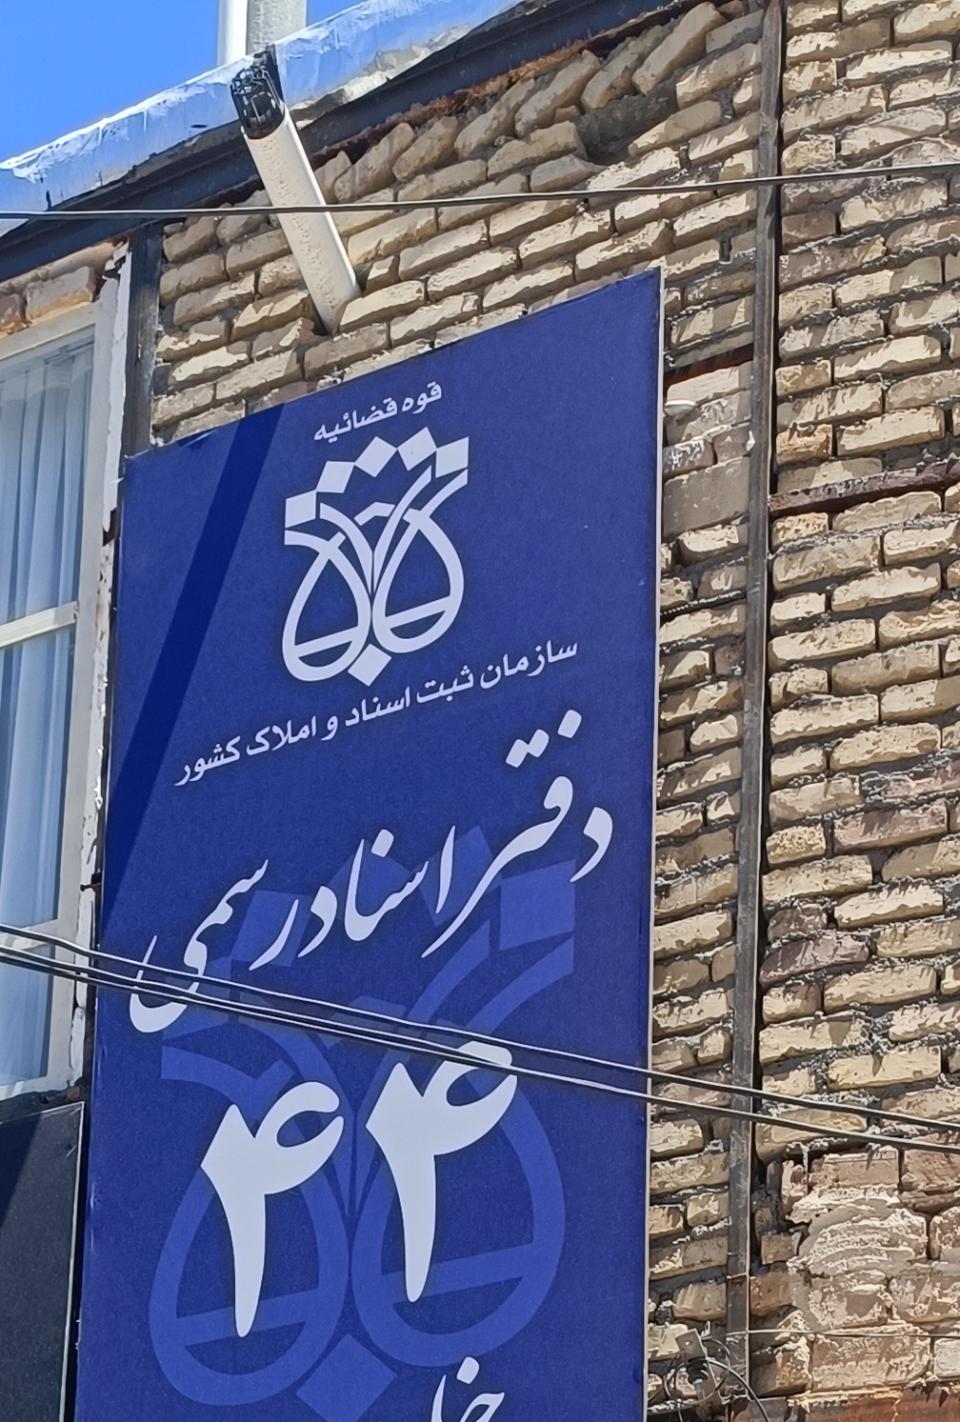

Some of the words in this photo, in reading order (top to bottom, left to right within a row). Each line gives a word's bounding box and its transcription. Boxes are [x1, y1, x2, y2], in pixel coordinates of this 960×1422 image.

[314, 396, 397, 444] قضائیه
[402, 382, 442, 414] قوه
[417, 666, 474, 704] ثبت
[479, 640, 578, 691] سازمان
[321, 717, 338, 742] و
[346, 687, 410, 727] اسناد
[174, 735, 242, 786] کشور
[247, 716, 317, 758] املاک
[422, 709, 614, 958] دفتر
[299, 824, 456, 958] اسناد
[129, 859, 299, 1034] رسمی
[200, 1039, 518, 1338] ۴۴
